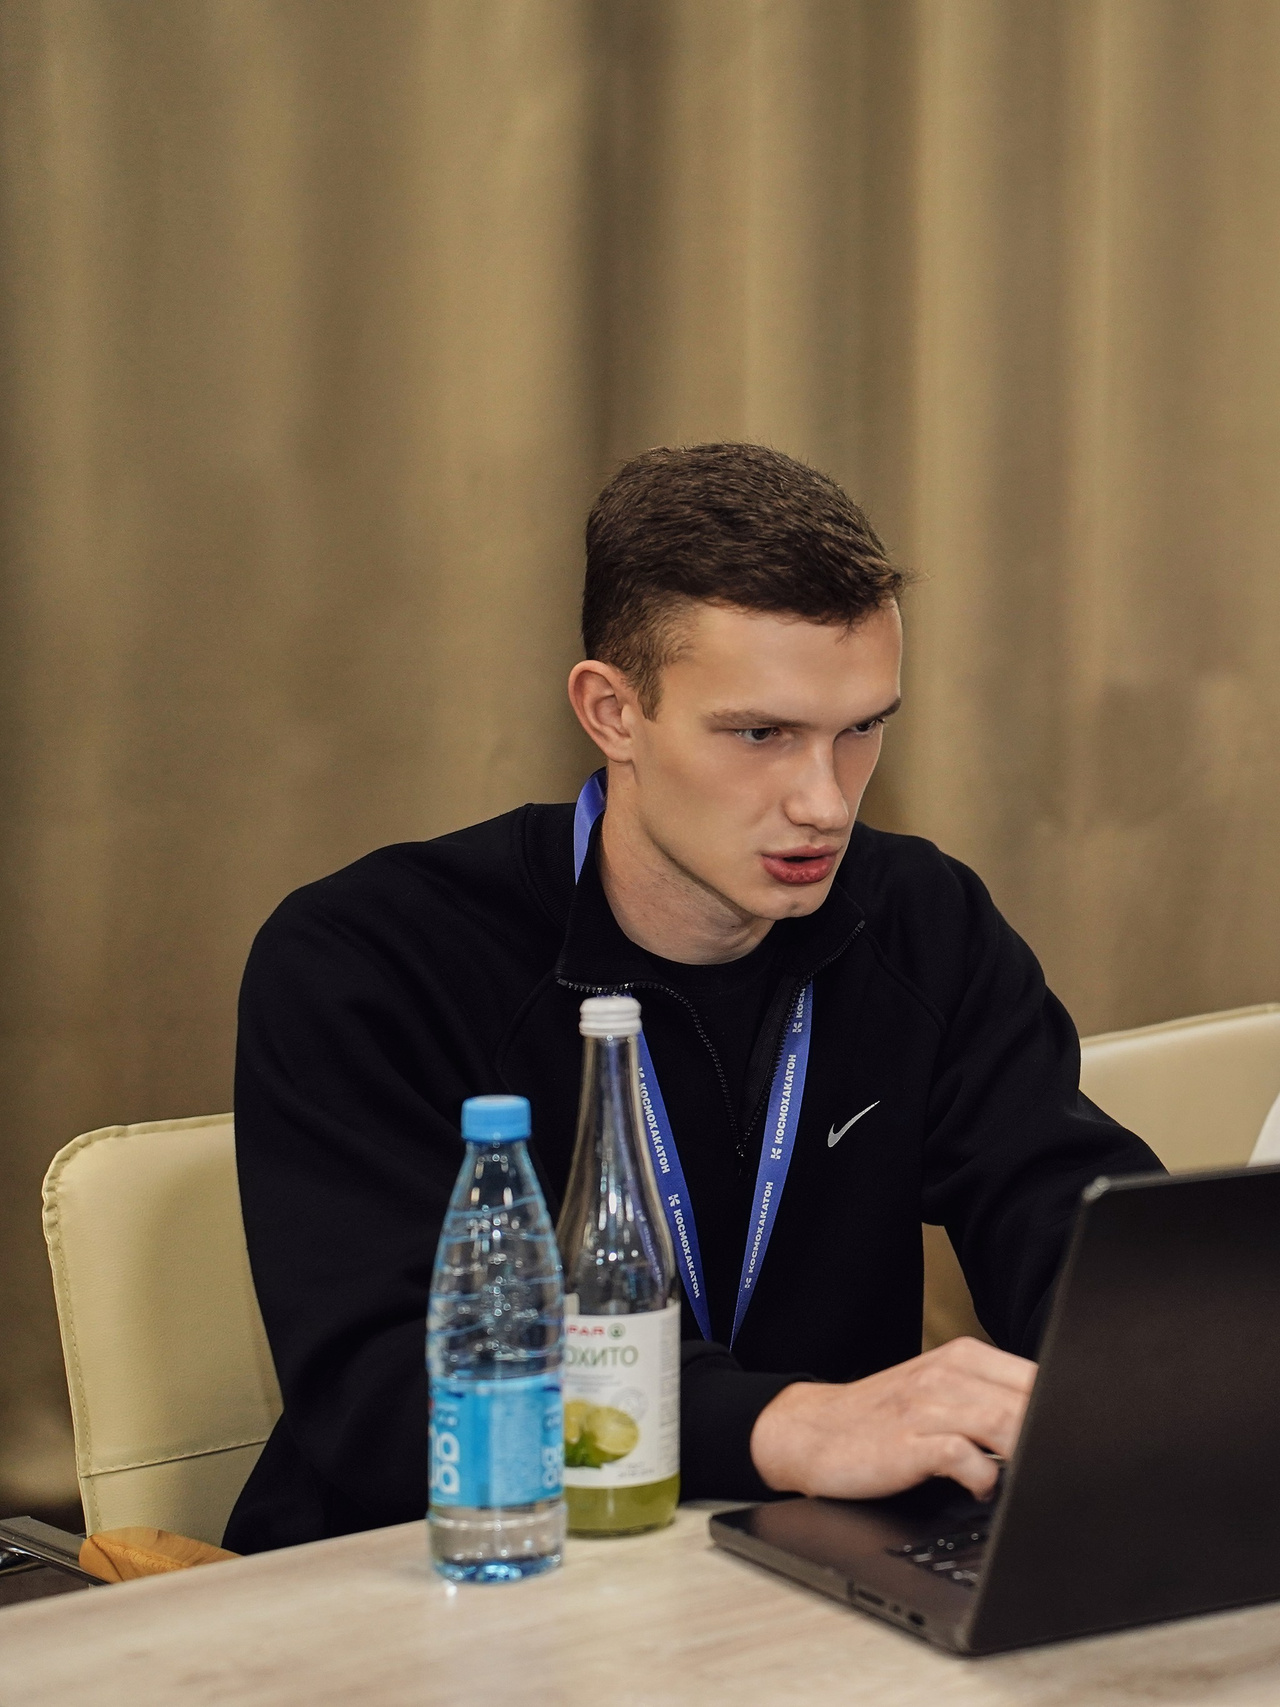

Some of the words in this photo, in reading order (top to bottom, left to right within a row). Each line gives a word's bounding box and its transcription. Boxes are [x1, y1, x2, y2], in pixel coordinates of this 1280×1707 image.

[638, 1082, 671, 1174] КОСМОХАКАТОН
[774, 1054, 797, 1144] КОСМОХАКАТОН
[673, 1208, 700, 1298] КОСМОХАКАТОН
[748, 1181, 774, 1273] КОСМОХАКАТОН
[565, 1345, 639, 1368] ОХИТО
[566, 1324, 605, 1337] PAR
